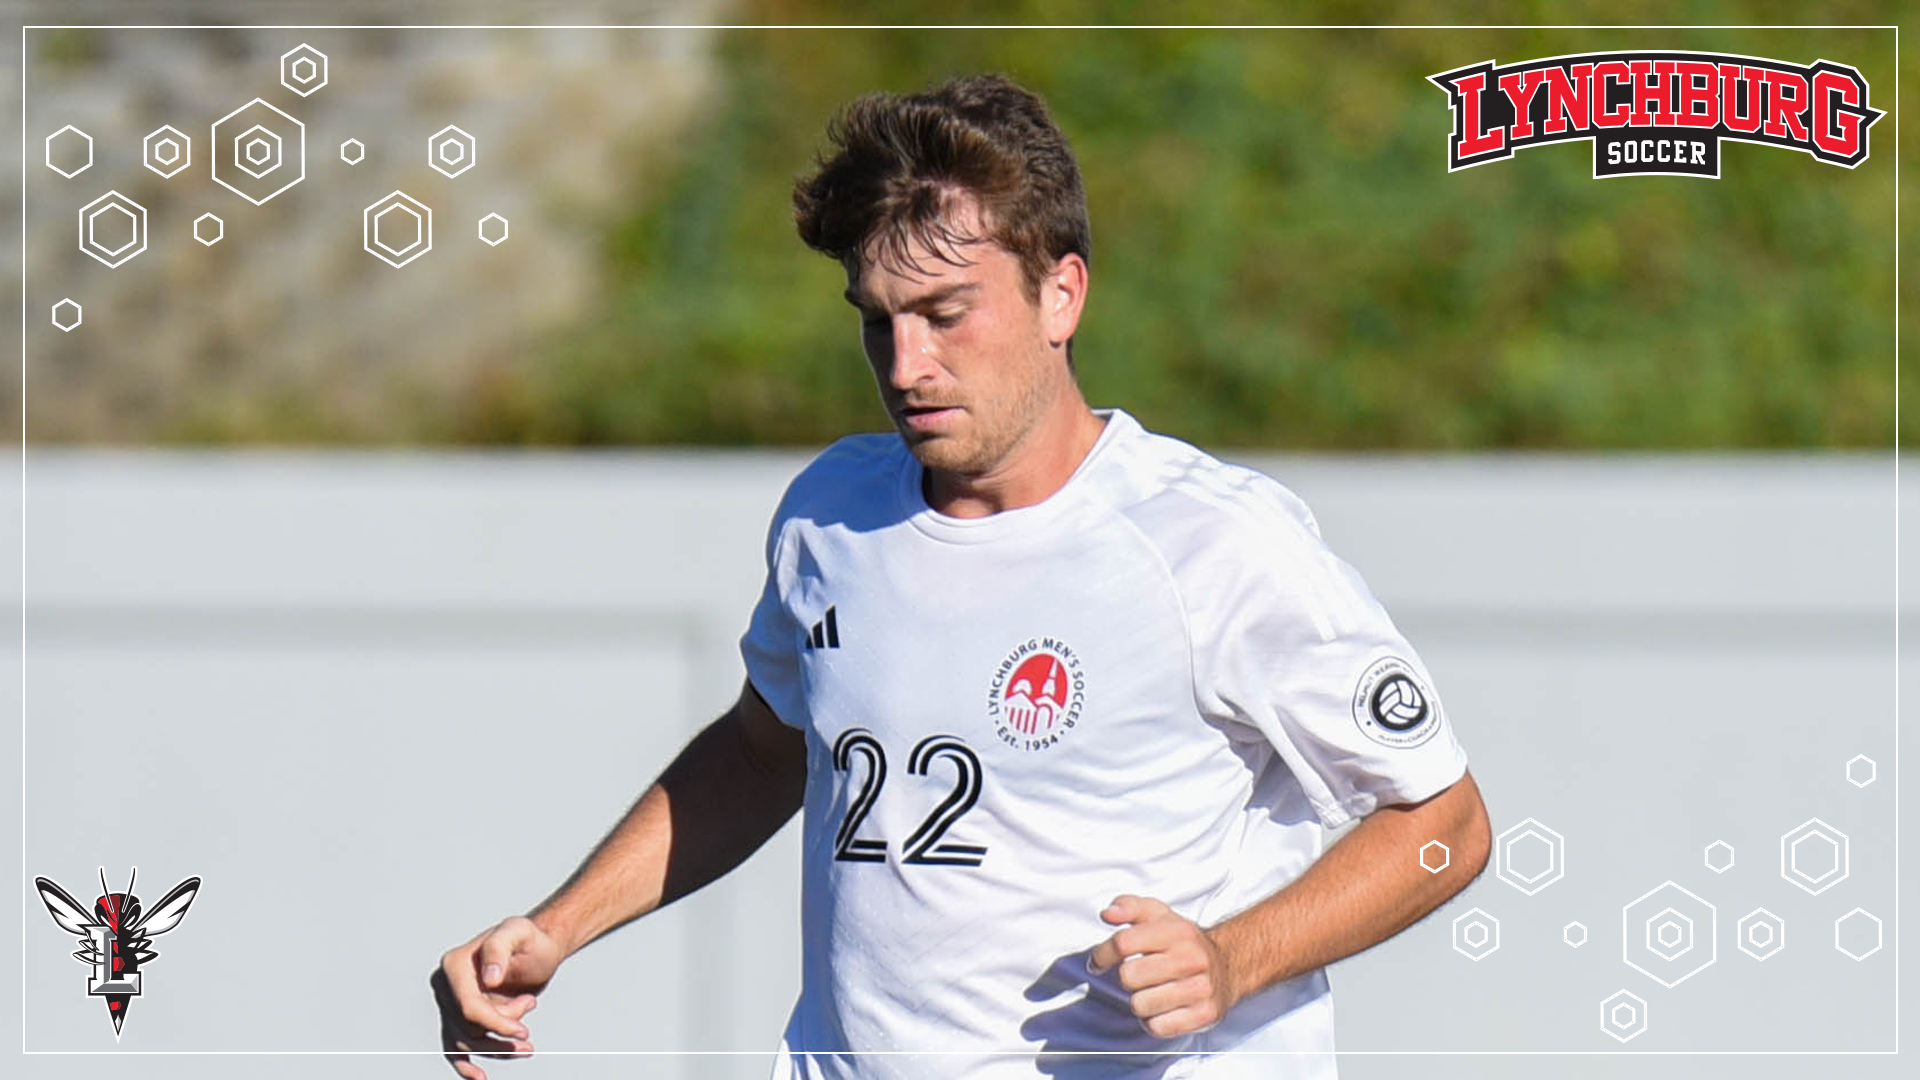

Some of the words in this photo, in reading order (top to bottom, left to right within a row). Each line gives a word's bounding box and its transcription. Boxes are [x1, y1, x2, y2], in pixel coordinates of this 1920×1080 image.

[988, 640, 1038, 716] LYNCHBURG
[1042, 638, 1080, 668] MEN'S
[1063, 671, 1085, 729] SOCCER
[997, 726, 1019, 749] Est.
[1025, 734, 1059, 751] 1954
[833, 727, 988, 868] 22
